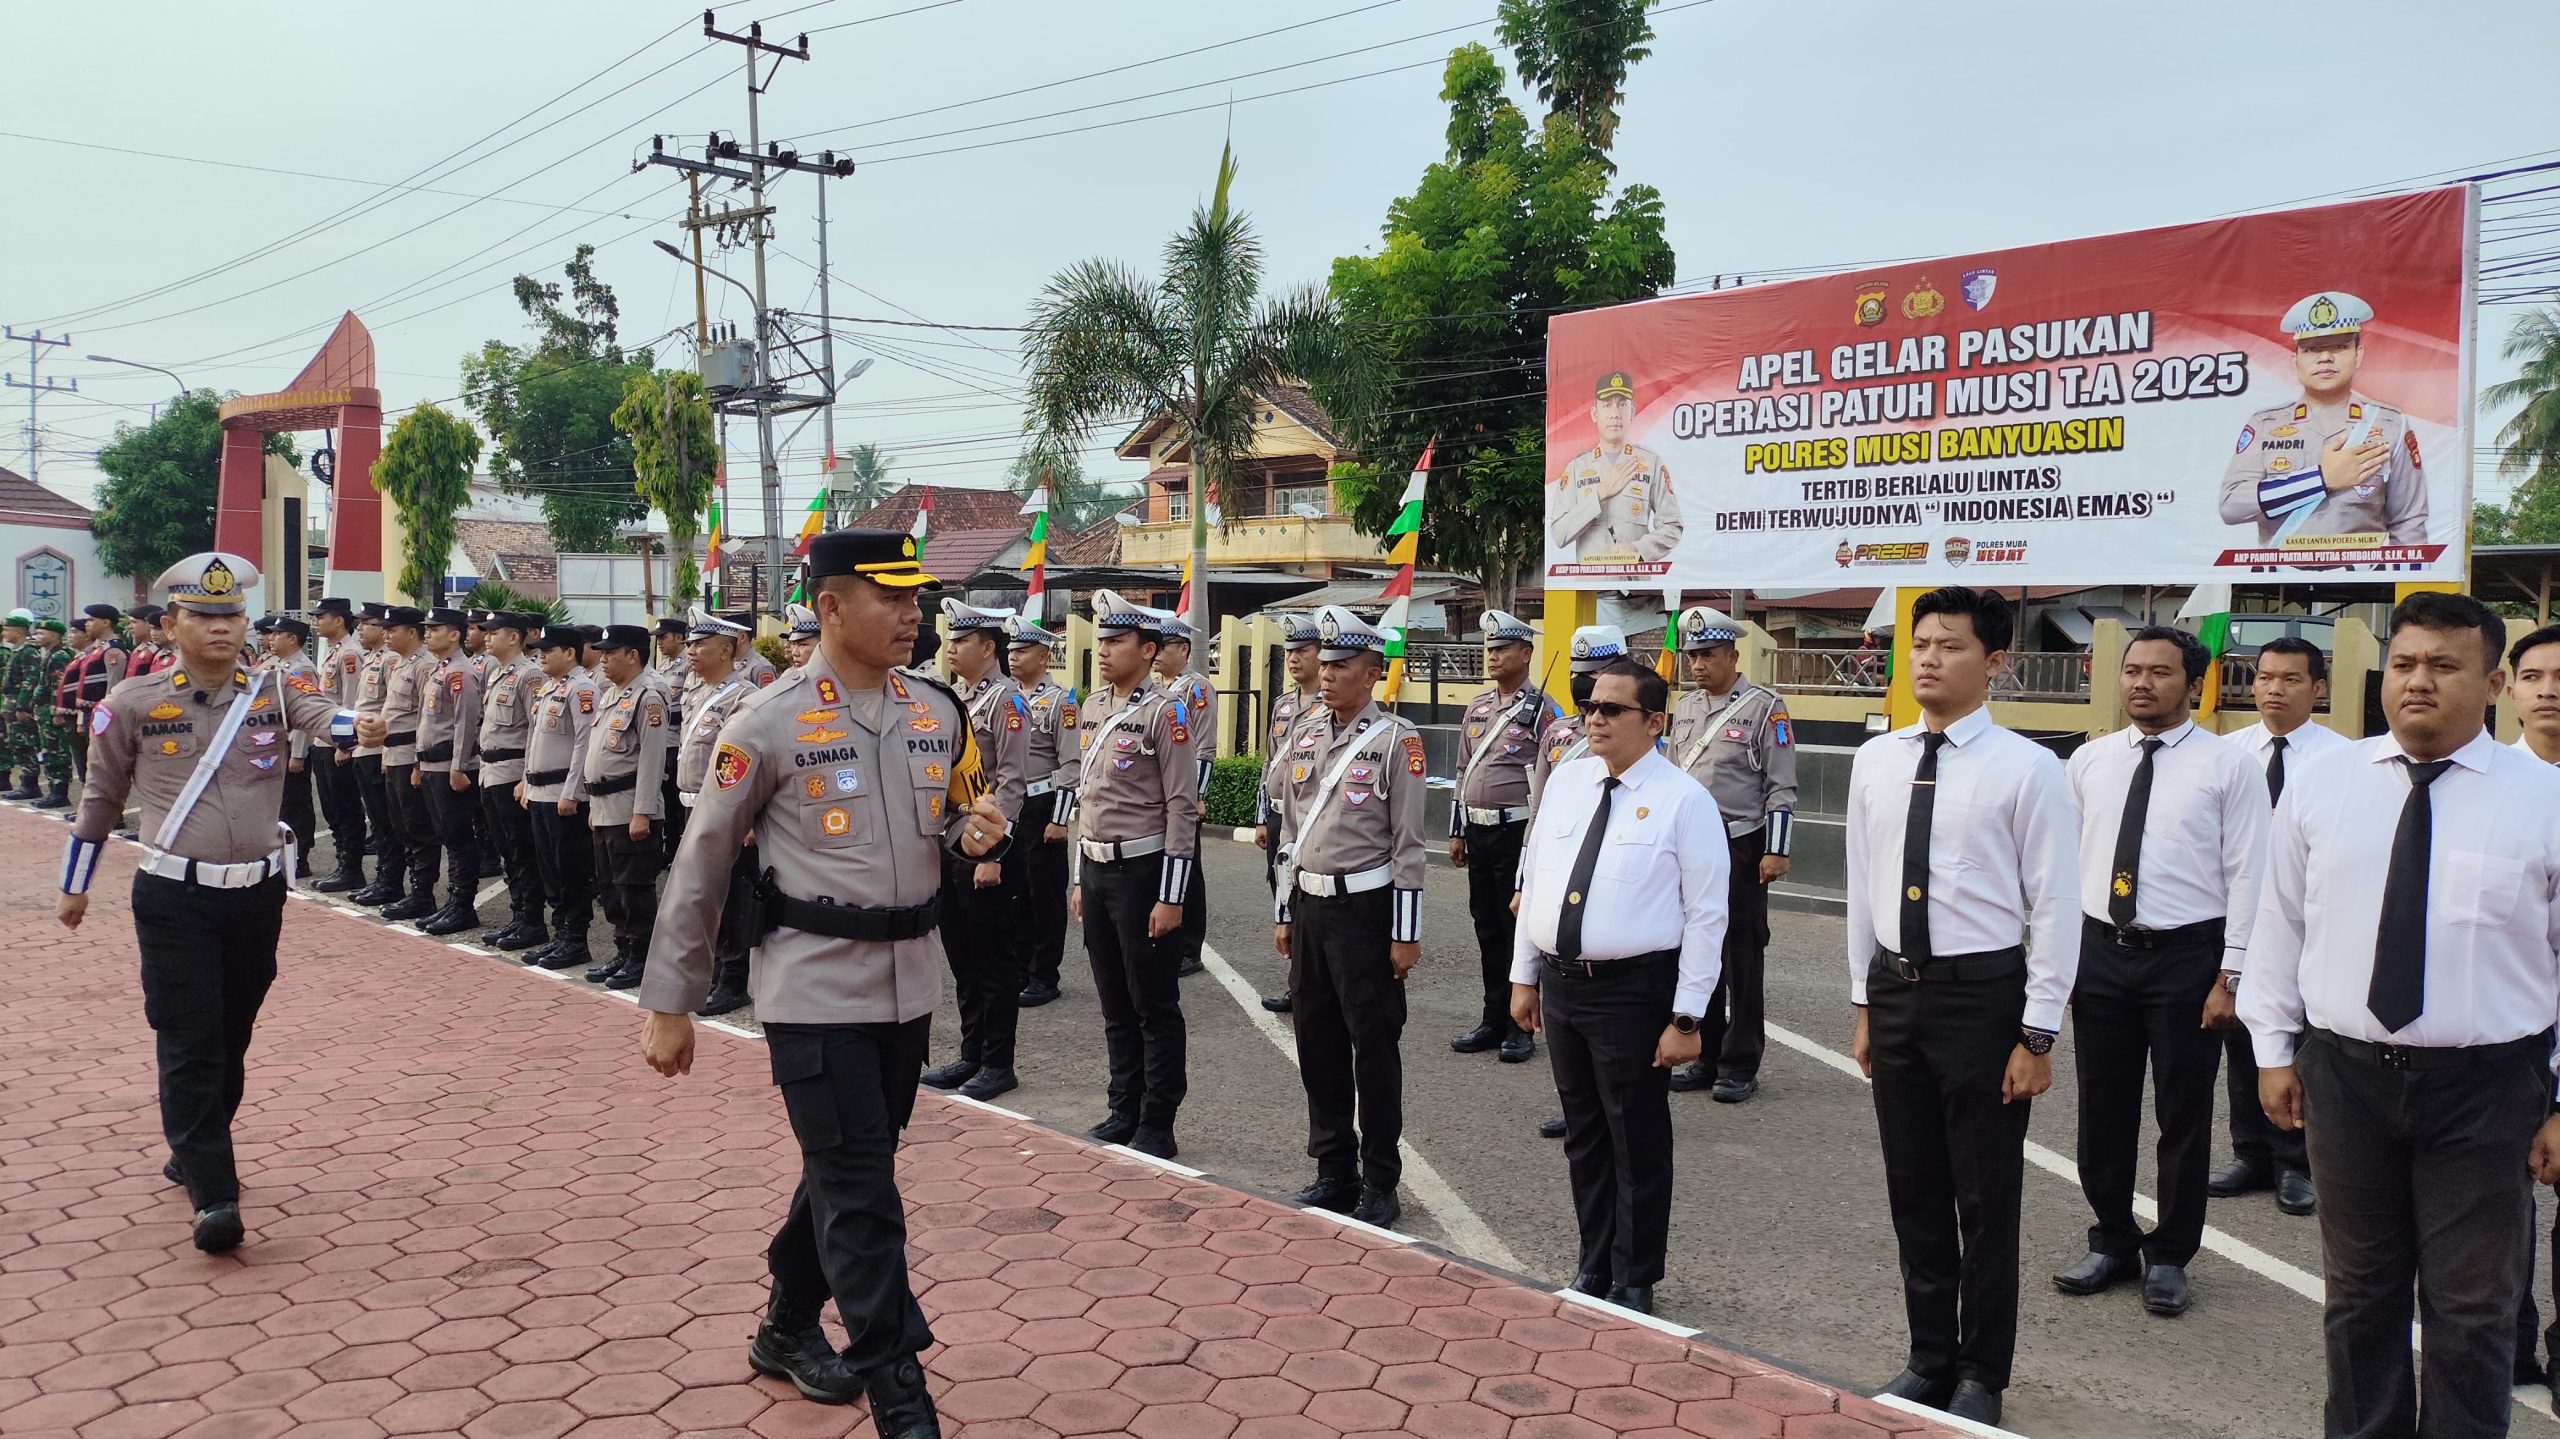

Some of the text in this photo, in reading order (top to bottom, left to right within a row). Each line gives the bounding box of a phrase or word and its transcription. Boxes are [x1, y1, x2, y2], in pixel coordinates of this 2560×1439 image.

[1737, 311, 2150, 391] APEL GELAR PASUKAN
[1673, 352, 2247, 437] OPERASI PATUH MUSI T.A 2025
[1745, 417, 2124, 472] POLRES MUSI BANYUASIN
[2261, 439, 2304, 451] PANDRI
[1631, 473, 1651, 484] OLRI
[1801, 467, 2057, 501] TERTIB BERLALU LINTAS
[1716, 510, 1762, 531] DEMI
[1768, 504, 1917, 529] TERWUJUDNYA
[1943, 496, 2069, 522] INDONESIA
[2077, 493, 2148, 517] EMAS
[1854, 542, 1930, 561] PRESISI
[1976, 540, 2028, 549] POLRES MUBA
[1976, 549, 2026, 561] HEBAT
[2233, 553, 2250, 563] AKP
[2250, 553, 2278, 562] PANDRI
[2279, 552, 2314, 562] PRATAMA
[2314, 552, 2340, 562] PUTRA
[2341, 551, 2384, 562] SIMBOLON,
[2407, 550, 2425, 560] M.A.
[1730, 718, 1753, 727] OLRI
[795, 738, 950, 768] G.SINAGA POLRI
[1355, 751, 1382, 763] OLRI
